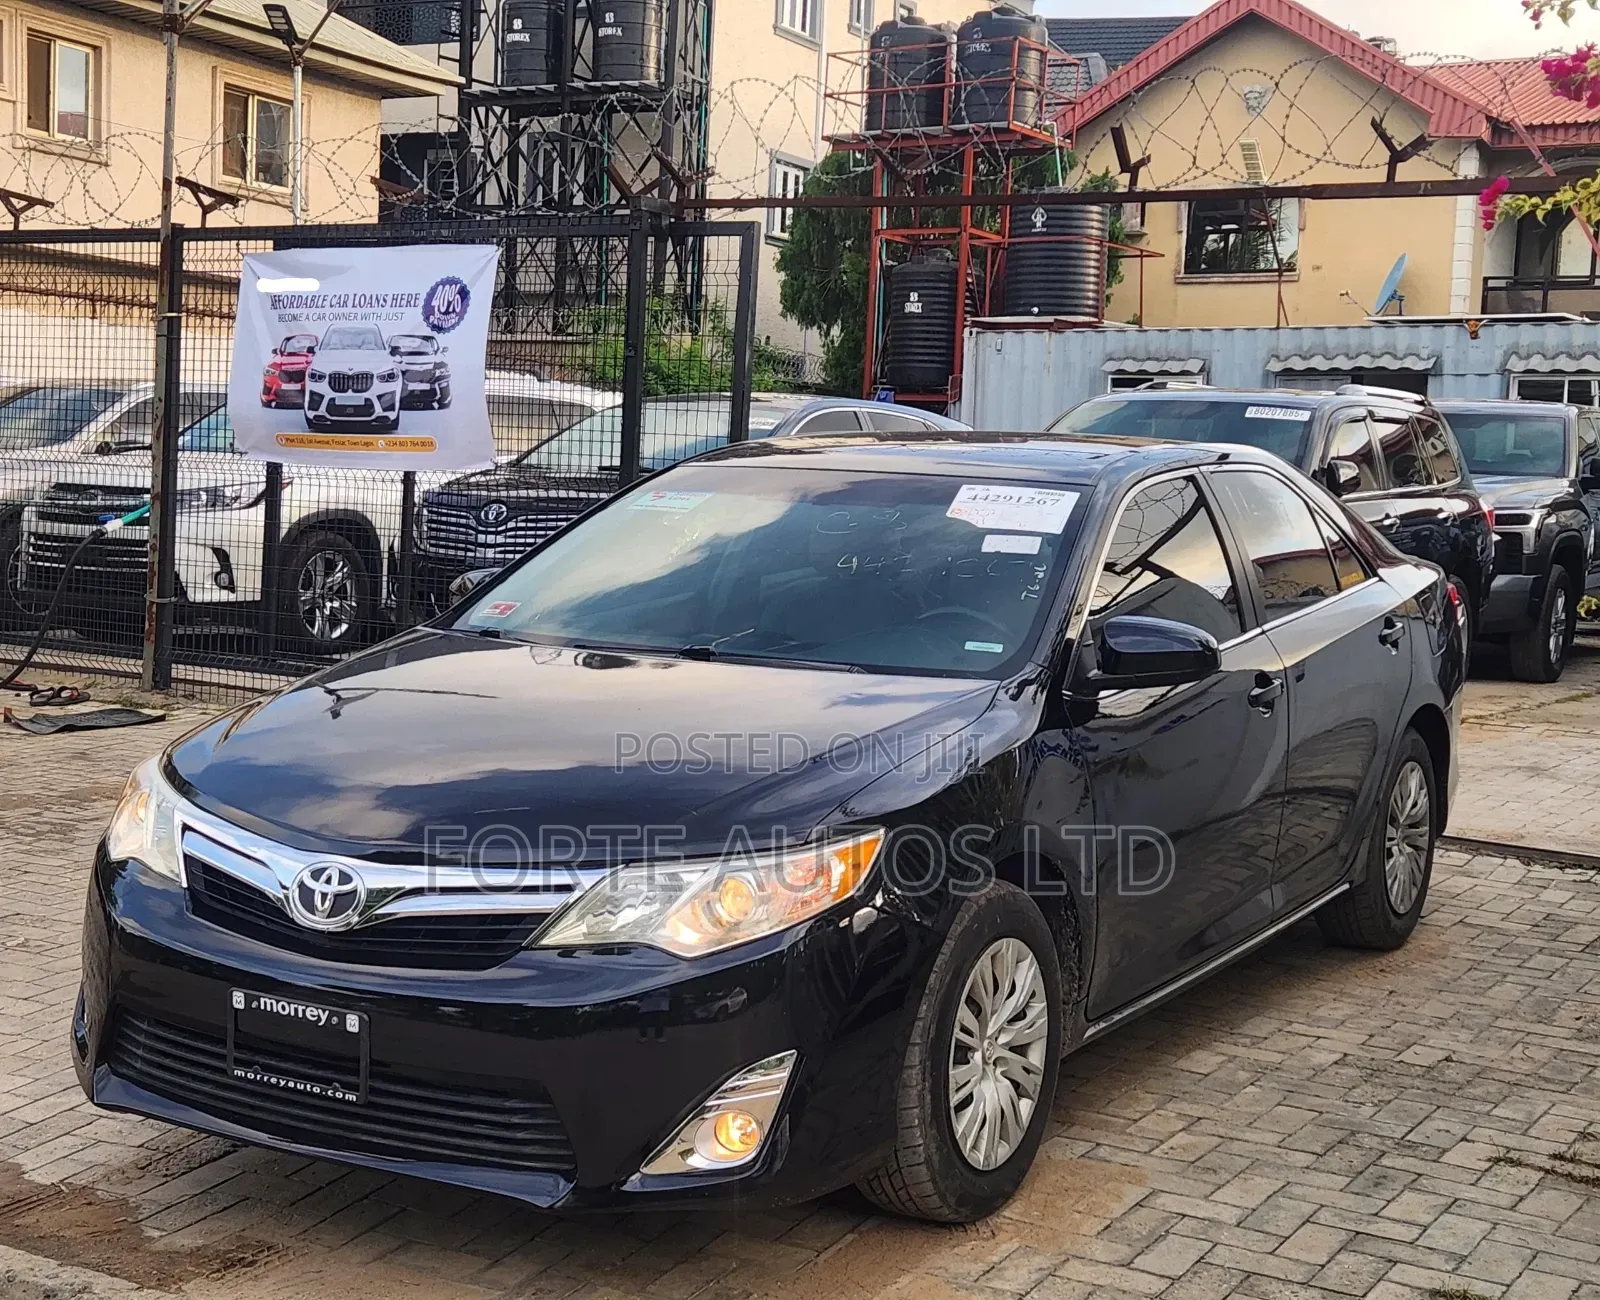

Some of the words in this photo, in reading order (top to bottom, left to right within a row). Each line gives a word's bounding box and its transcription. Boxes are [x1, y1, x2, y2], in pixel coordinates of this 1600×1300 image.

[506, 32, 531, 43] STOREX
[270, 292, 328, 310] AFFORDABLE
[329, 293, 350, 309] CAR
[351, 293, 388, 309] LOANS
[389, 292, 421, 308] HERE
[431, 284, 462, 313] 40%
[278, 312, 303, 323] BECOME
[304, 312, 311, 322] A
[311, 312, 327, 322] CAR
[328, 312, 359, 322] OWNER
[359, 311, 382, 321] WITH
[382, 311, 405, 321] JUST
[434, 311, 457, 321] DOWN
[360, 440, 374, 448] Lagos
[966, 492, 1061, 507] 44291267
[259, 997, 330, 1026] morrey
[233, 1069, 357, 1103] morreyauto.com
